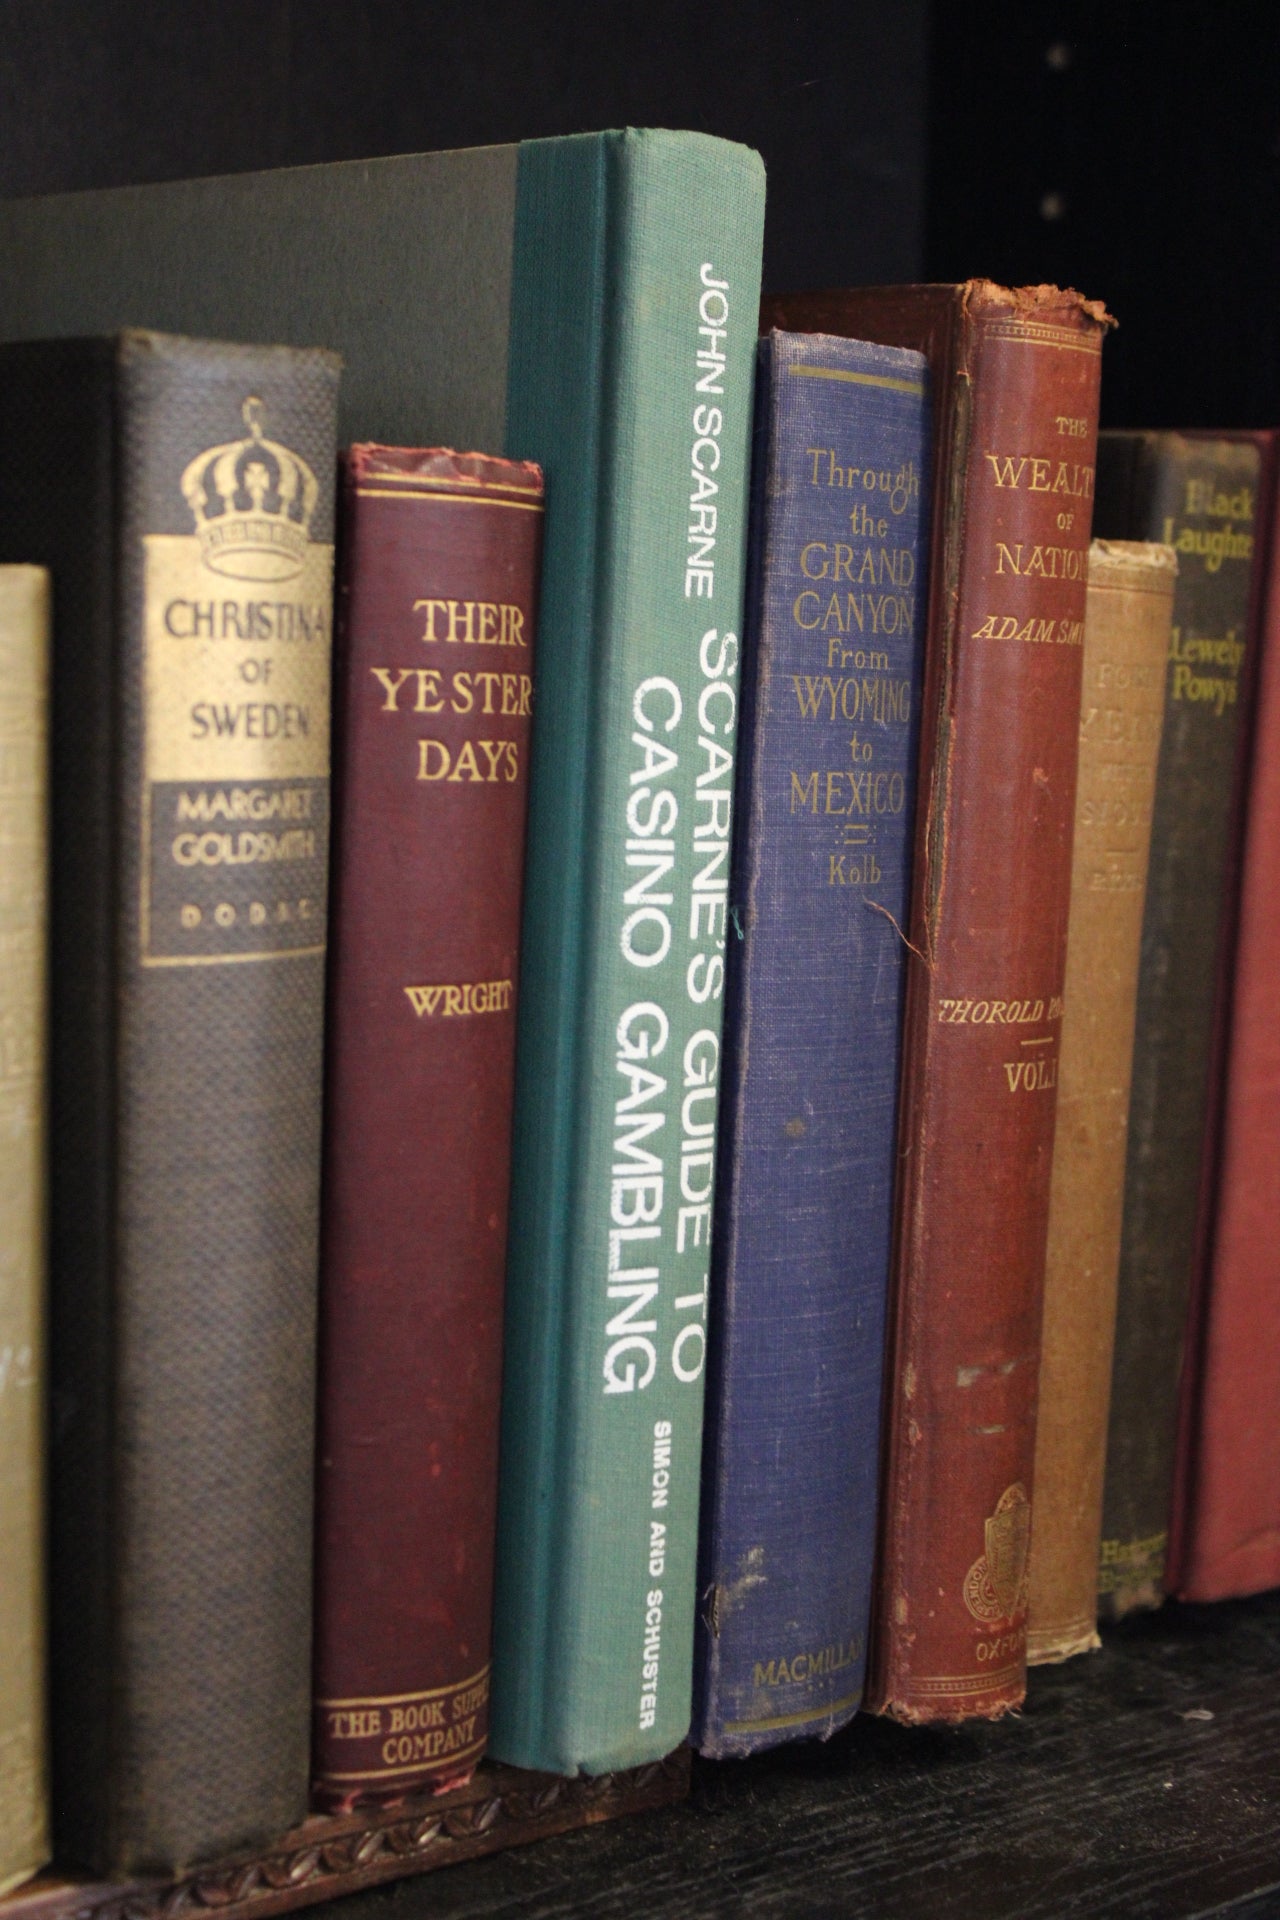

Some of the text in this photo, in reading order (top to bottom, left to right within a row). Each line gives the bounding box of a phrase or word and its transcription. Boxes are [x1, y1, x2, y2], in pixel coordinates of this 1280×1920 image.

[684, 262, 729, 599] JOHN SCARNE
[1056, 416, 1088, 439] THE
[806, 448, 919, 515] Through
[849, 503, 889, 538] the
[1056, 512, 1075, 531] OF
[800, 542, 916, 587] GRAND
[412, 599, 527, 647] THEIR
[793, 590, 915, 636] CANYON
[971, 615, 1057, 644] ADAM
[239, 658, 273, 684] OF
[826, 637, 890, 670] From
[369, 666, 533, 716] YESTER
[792, 674, 912, 723] WYOMING
[190, 702, 310, 740] SWEDEN
[416, 739, 519, 783] DAYS
[849, 730, 874, 763] to
[790, 771, 906, 815] MEXICO
[828, 855, 882, 886] Kolb
[403, 979, 513, 1018] WRIGHT
[937, 999, 1045, 1024] THOROLD
[603, 676, 683, 1395] CASINO GAMBLING
[676, 1028, 720, 1254] GUIDE
[672, 1272, 709, 1383] TO
[639, 1420, 672, 1730] SIMON AND SCHUSTER
[328, 1710, 381, 1739] THE
[390, 1701, 446, 1733] BOOK
[382, 1716, 476, 1765] COMPANY
